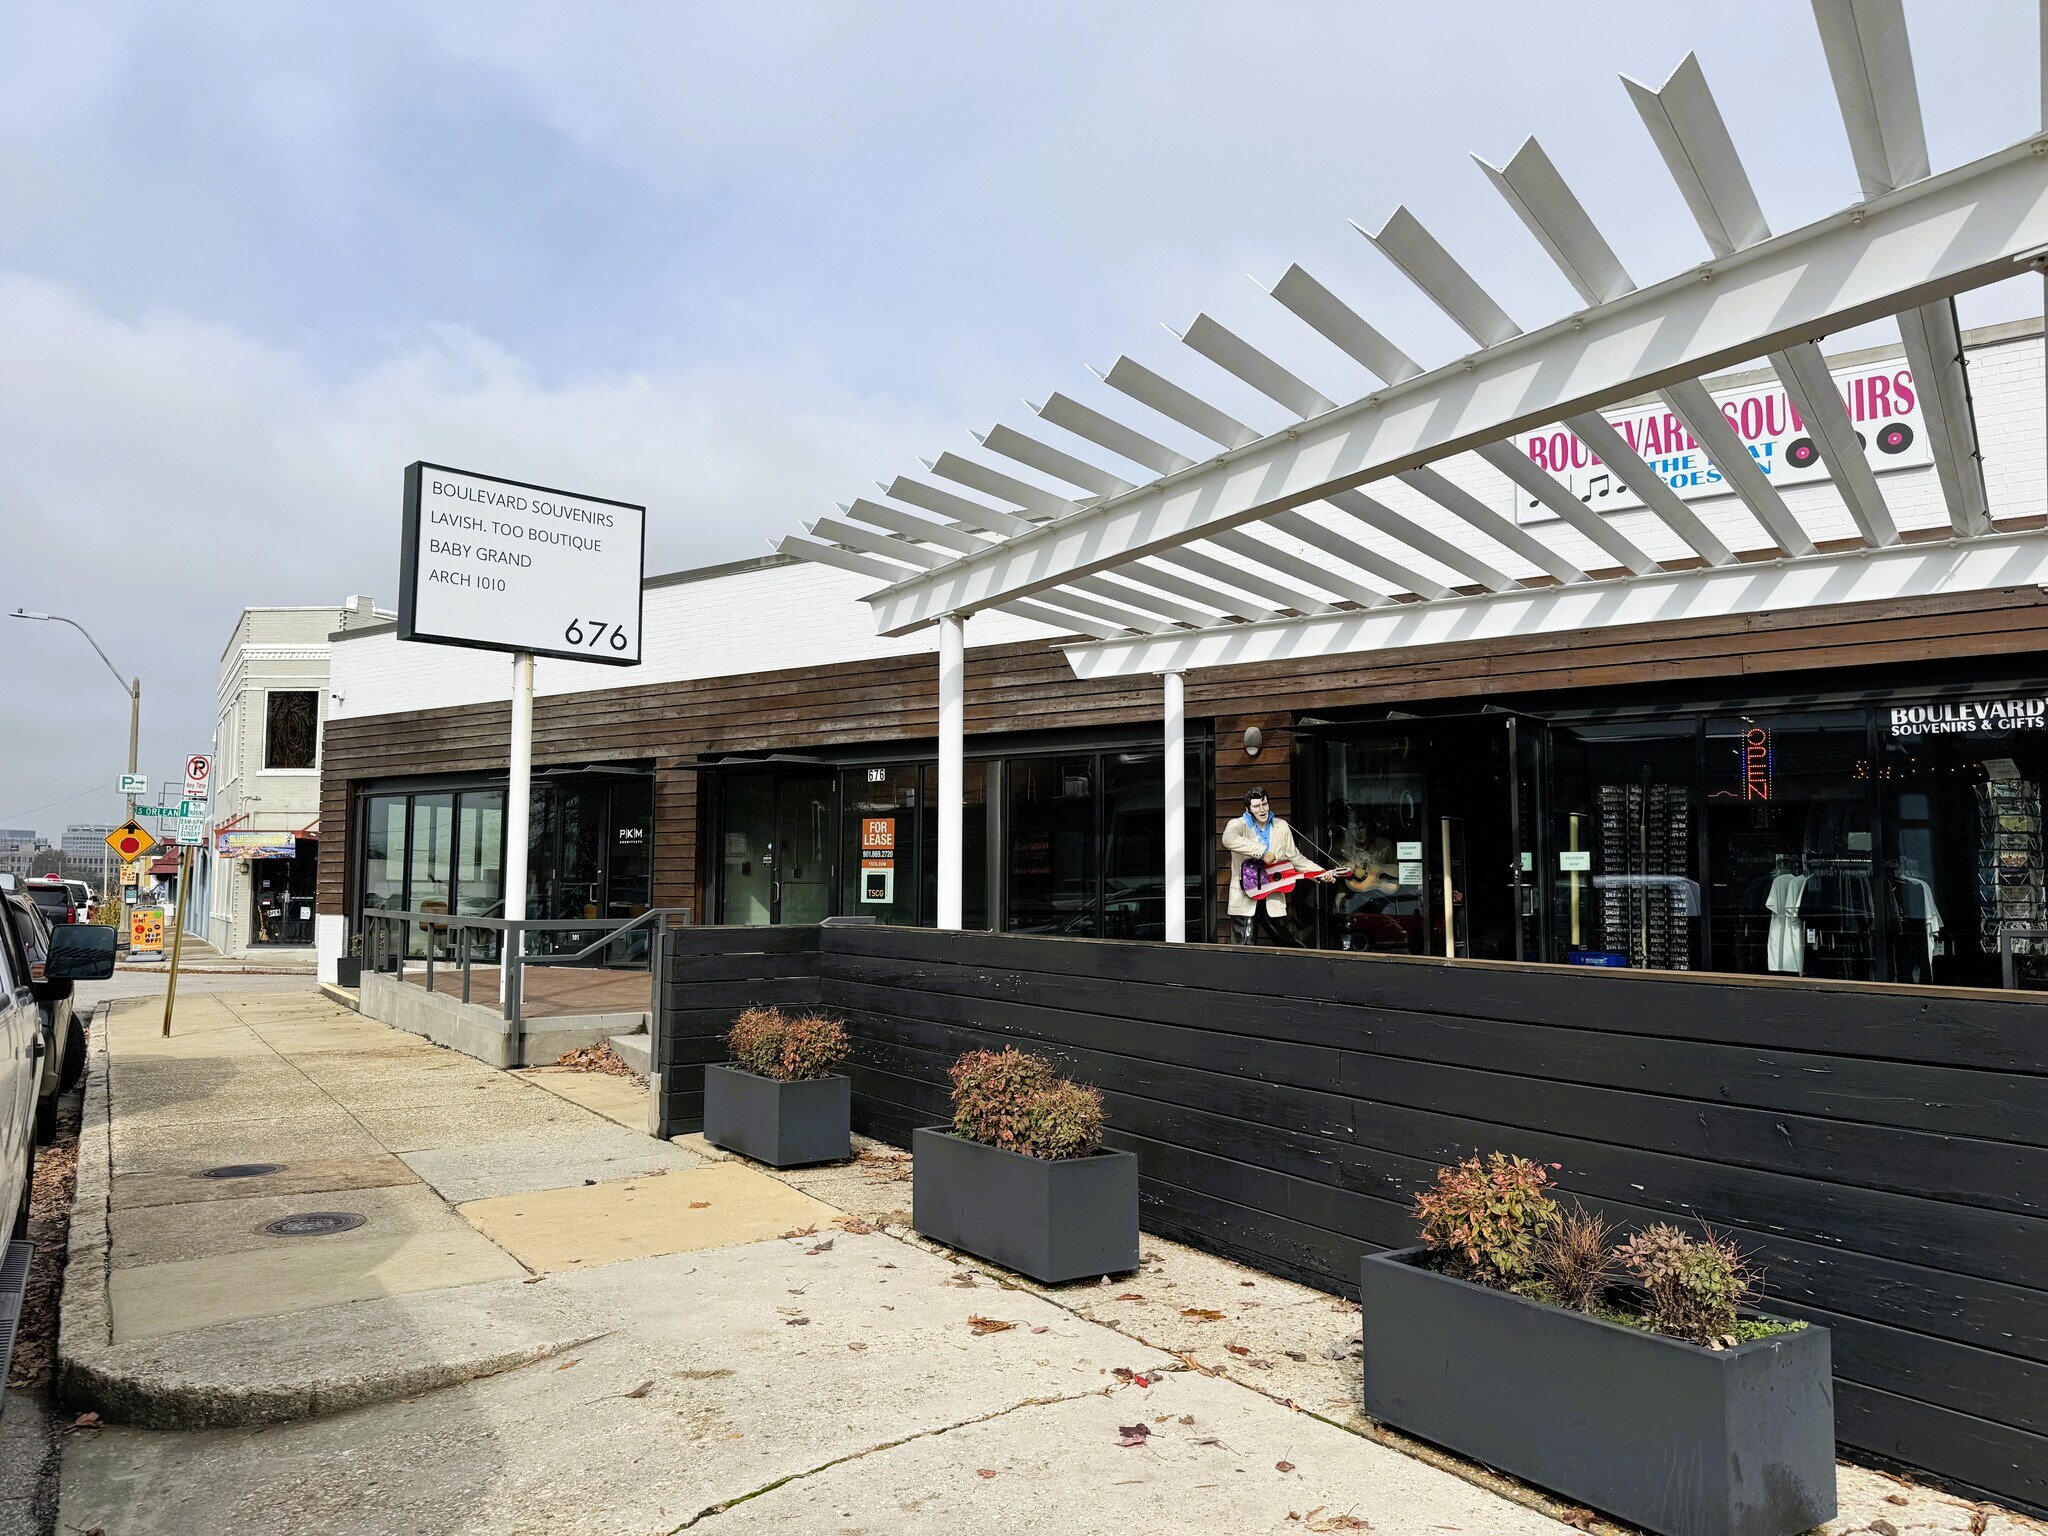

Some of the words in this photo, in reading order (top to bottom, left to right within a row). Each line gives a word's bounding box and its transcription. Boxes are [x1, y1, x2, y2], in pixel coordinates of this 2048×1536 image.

[1529, 412, 1703, 473] BOUVAR
[1720, 370, 1915, 441] SOUIRS
[1647, 455, 1698, 474] THE
[432, 480, 528, 511] BOULEVARD
[531, 500, 614, 528] SOUVENIRS
[430, 510, 487, 533] LAVISH.
[491, 521, 524, 538] TOO
[528, 528, 602, 552] BOUTIQUE
[430, 539, 472, 558] BABY
[476, 547, 532, 568] GRAND
[429, 569, 471, 587] ARCH
[565, 618, 628, 651] 676
[1890, 699, 2045, 726] BOULEVARD
[1891, 720, 1977, 737] SOUVENIRS
[1981, 719, 1993, 731] &
[1997, 716, 2045, 730] GIFTS
[1747, 728, 1767, 800] OPEN
[868, 768, 885, 781] 676
[186, 782, 196, 790] Any
[137, 807, 143, 815] S
[869, 821, 887, 834] FOR
[864, 833, 893, 846] LEASE
[868, 889, 884, 897] TSCG
